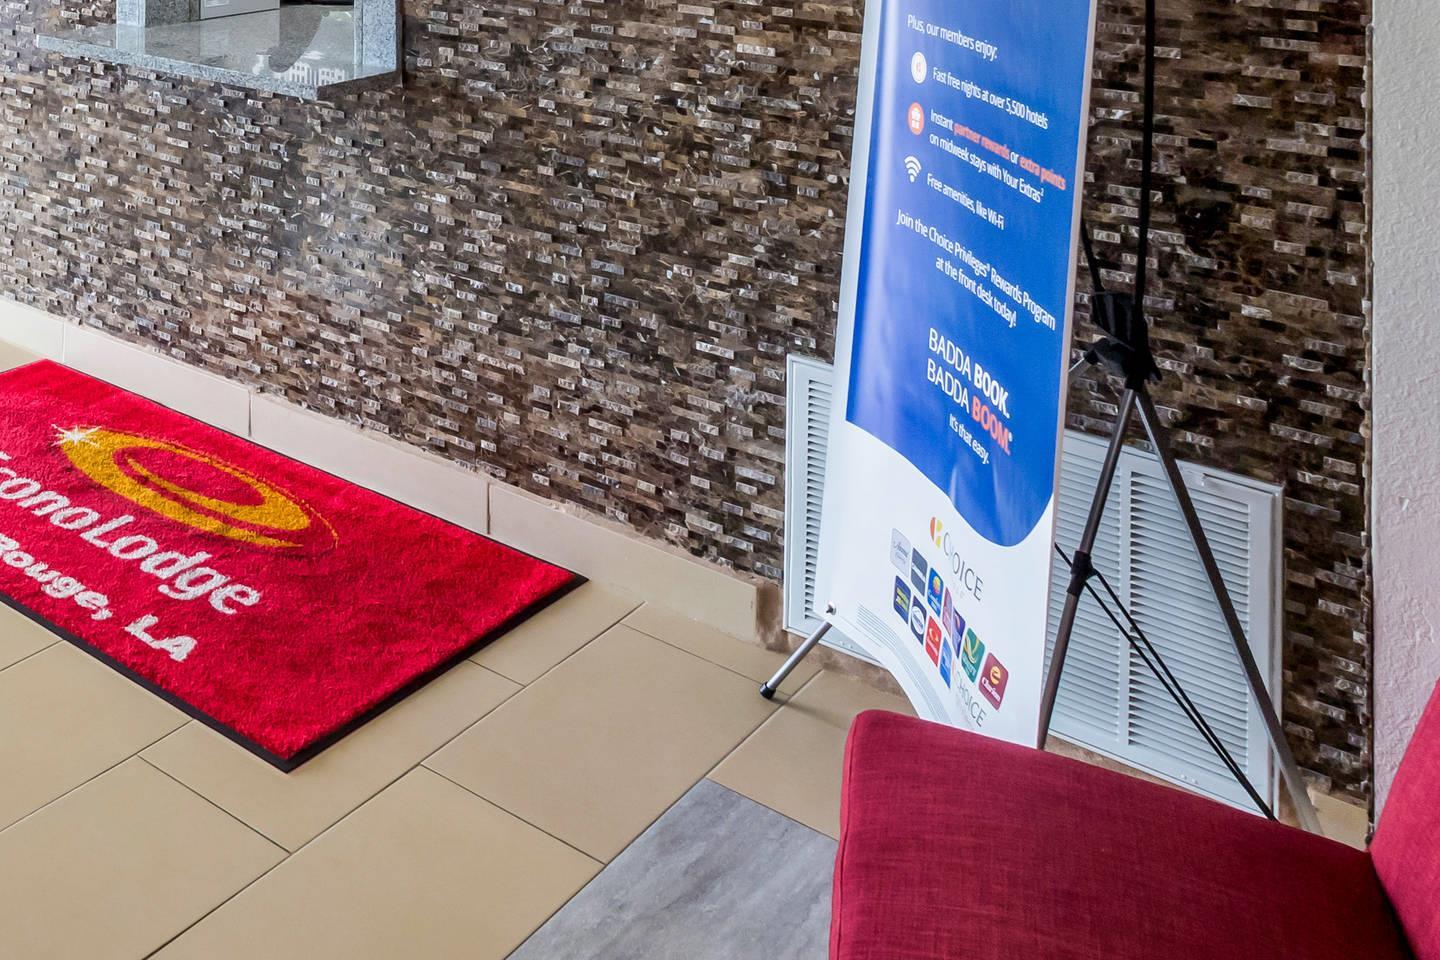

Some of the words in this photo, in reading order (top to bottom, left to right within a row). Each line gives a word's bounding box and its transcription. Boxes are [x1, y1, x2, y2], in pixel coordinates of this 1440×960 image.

[907, 14, 926, 34] Plus,
[926, 23, 940, 37] our
[940, 29, 975, 51] members
[975, 39, 998, 62] enjoy:
[933, 66, 947, 85] Fast
[947, 71, 961, 90] free
[961, 79, 981, 99] nights
[981, 89, 990, 103] at
[989, 93, 1005, 109] over
[1025, 105, 1049, 131] hotels
[929, 133, 940, 147] on
[939, 138, 969, 162] midweek
[969, 153, 987, 173] stays
[986, 162, 1002, 181] with
[1002, 167, 1019, 189] Your
[930, 108, 954, 132] Instant
[1010, 151, 1019, 165] or
[1019, 156, 1040, 177] extra
[1040, 166, 1067, 191] points
[927, 172, 943, 192] Free
[942, 184, 976, 214] amenities,
[975, 199, 988, 220] like
[987, 208, 1005, 231] Wi-Fi
[896, 208, 914, 229] Join
[914, 218, 929, 238] the
[928, 226, 954, 254] Choice
[990, 267, 1023, 304] Rewards
[1022, 291, 1057, 331] Program
[935, 257, 944, 272] at
[944, 260, 958, 281] the
[958, 268, 977, 295] front
[976, 282, 994, 309] desk
[993, 296, 1018, 329] today!
[926, 357, 970, 414] BADDA
[928, 327, 972, 381] BADDA
[973, 362, 1010, 419] BOOK.
[958, 423, 972, 447] that
[971, 439, 990, 465] easy.
[123, 613, 199, 662] LA
[981, 677, 1001, 702] Clarion
